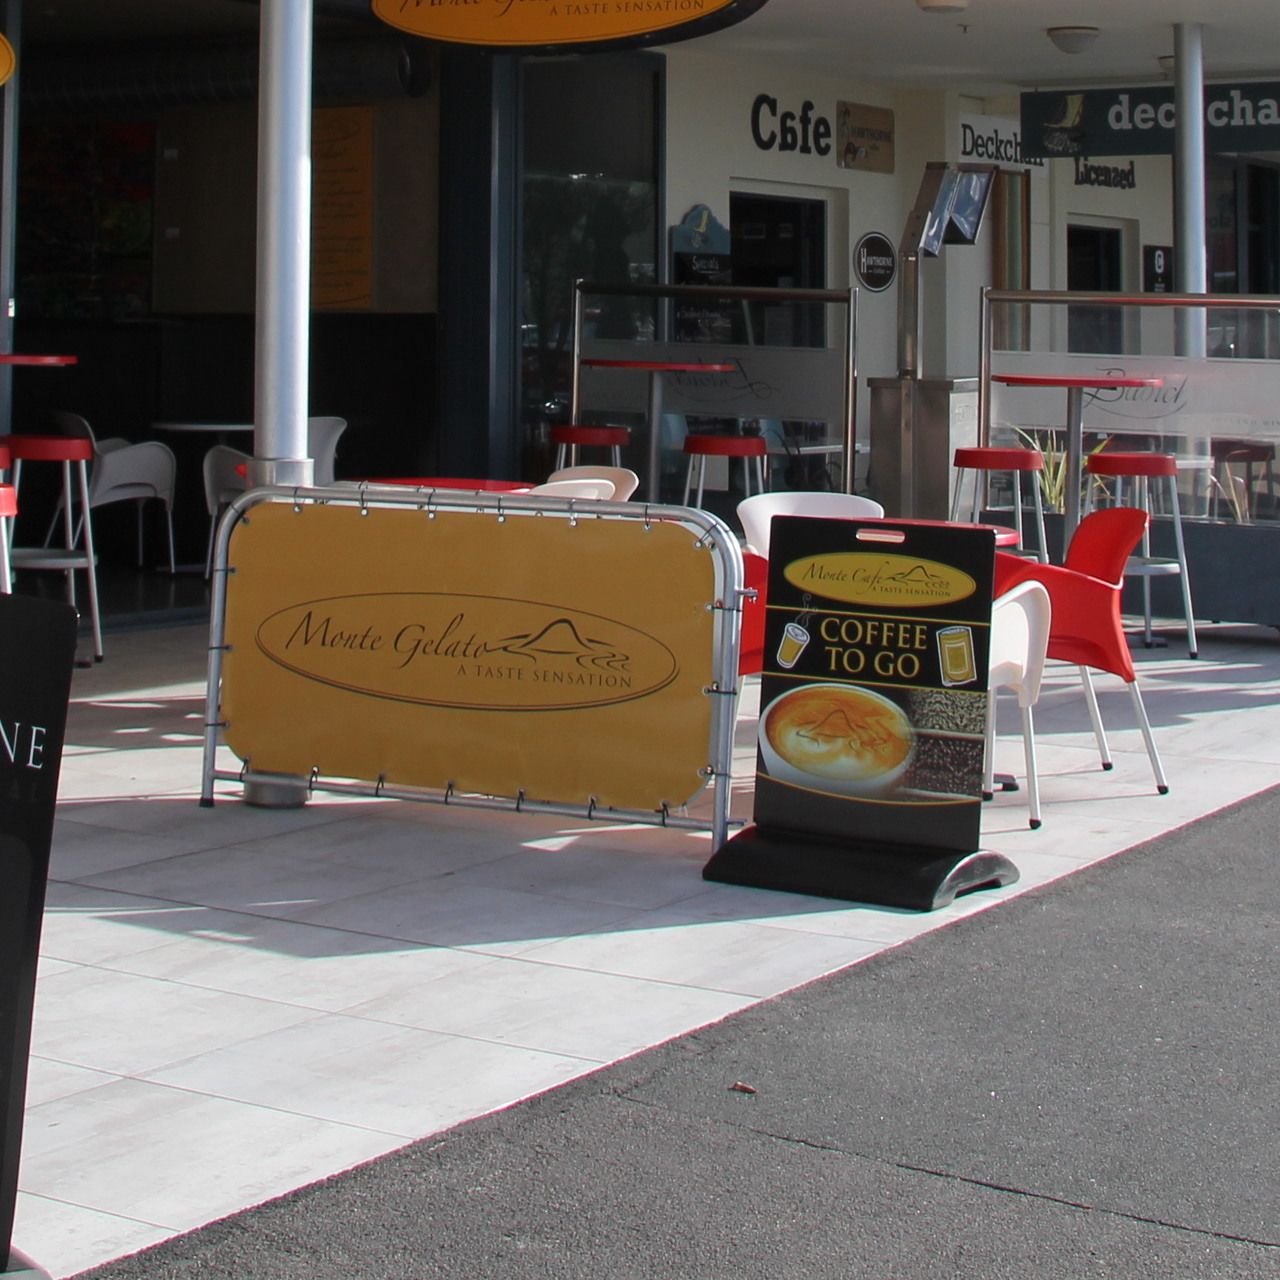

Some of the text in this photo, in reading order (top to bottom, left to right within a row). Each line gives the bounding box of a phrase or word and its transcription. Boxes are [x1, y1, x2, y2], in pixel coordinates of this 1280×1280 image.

[550, 0, 705, 16] A TASTE SENSATION
[751, 93, 832, 156] Cafe
[802, 562, 847, 582] Monte
[879, 585, 902, 595] TASTE
[905, 588, 952, 598] SENSATION
[284, 610, 491, 669] Monte Gelato
[820, 617, 928, 650] COFFEE
[457, 663, 634, 688] A TASTE SENSATION
[824, 646, 921, 678] TO GO
